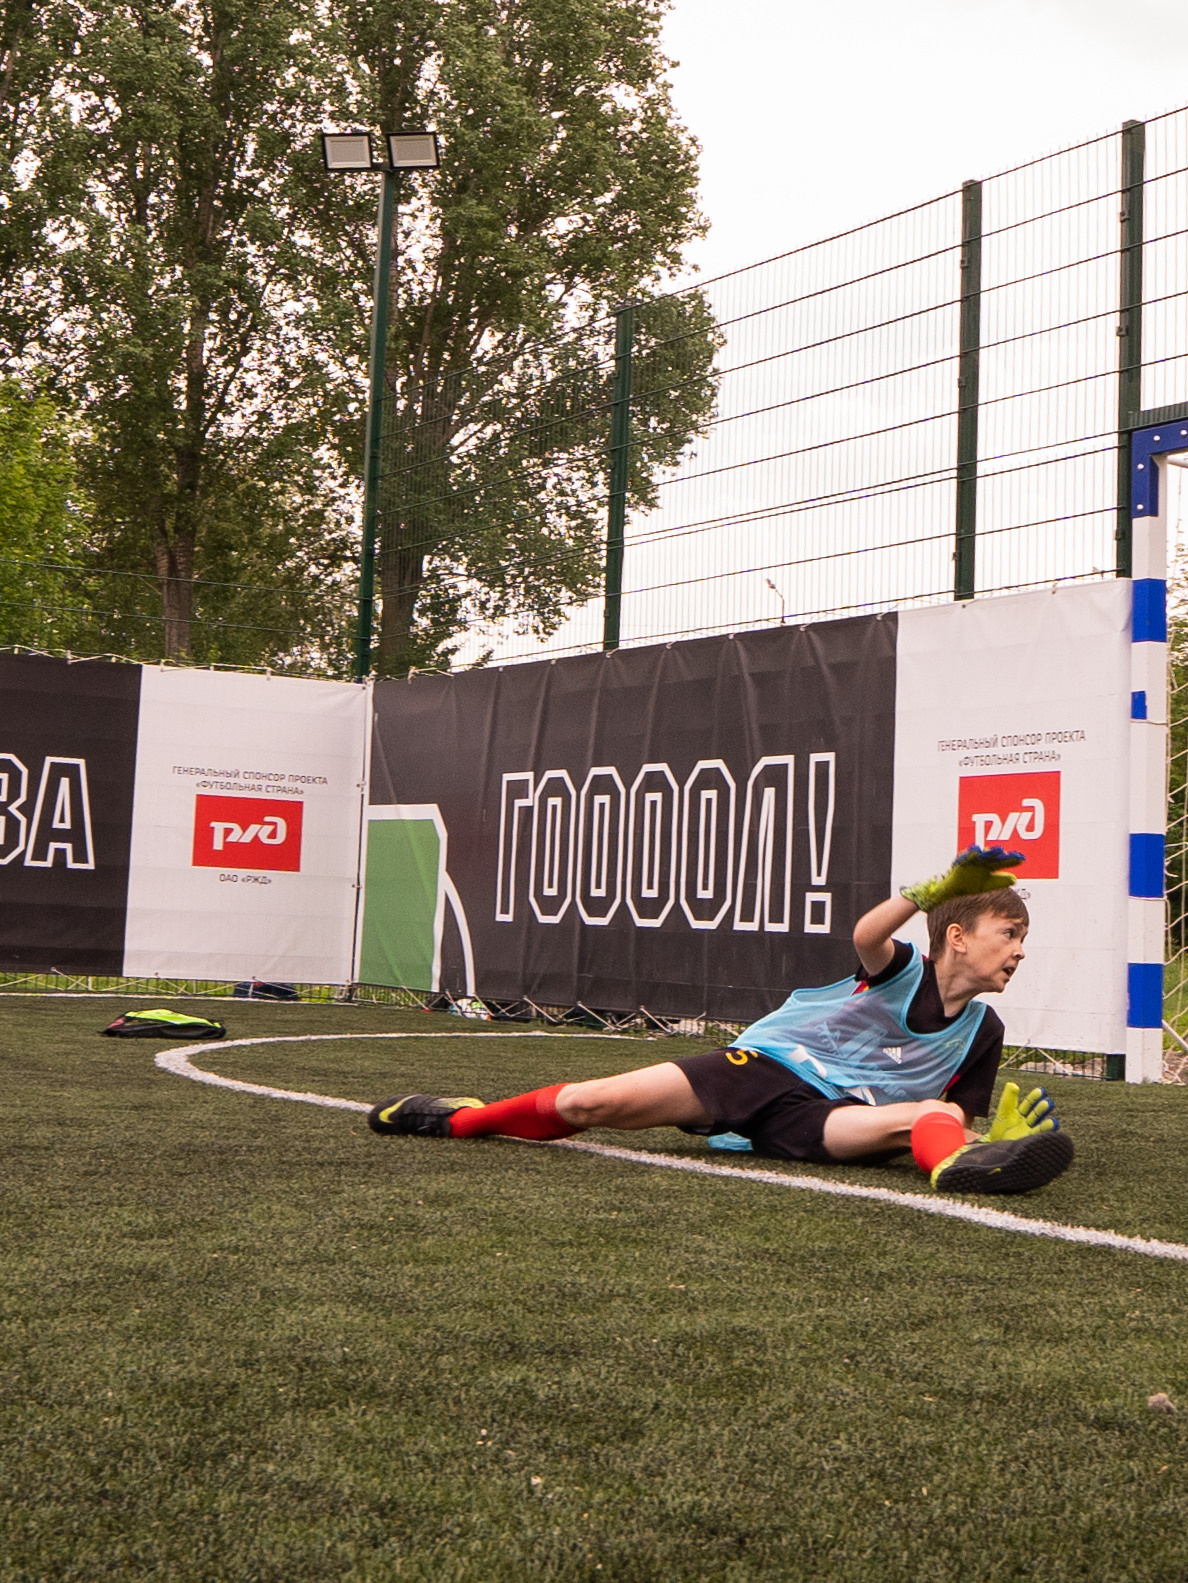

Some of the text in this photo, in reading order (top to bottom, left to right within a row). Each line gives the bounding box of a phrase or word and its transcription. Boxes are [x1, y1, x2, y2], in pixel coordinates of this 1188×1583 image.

[937, 729, 1086, 752] ГЕНЕРАЛЬНЫЙ СПОНСОР ПРОЕКТА
[958, 750, 1062, 767] «ФУТБОЛЬНАЯ СТРАНА»
[172, 765, 328, 786] ГЕНЕРАЛЬНЫЙ СПОНСОР ПРОЕКТА
[195, 780, 304, 796] «ФУТБОЛЬНАЯ СТРАНА»
[495, 751, 836, 934] ГООООЛ!
[219, 873, 272, 885] ОАО «РЖД»
